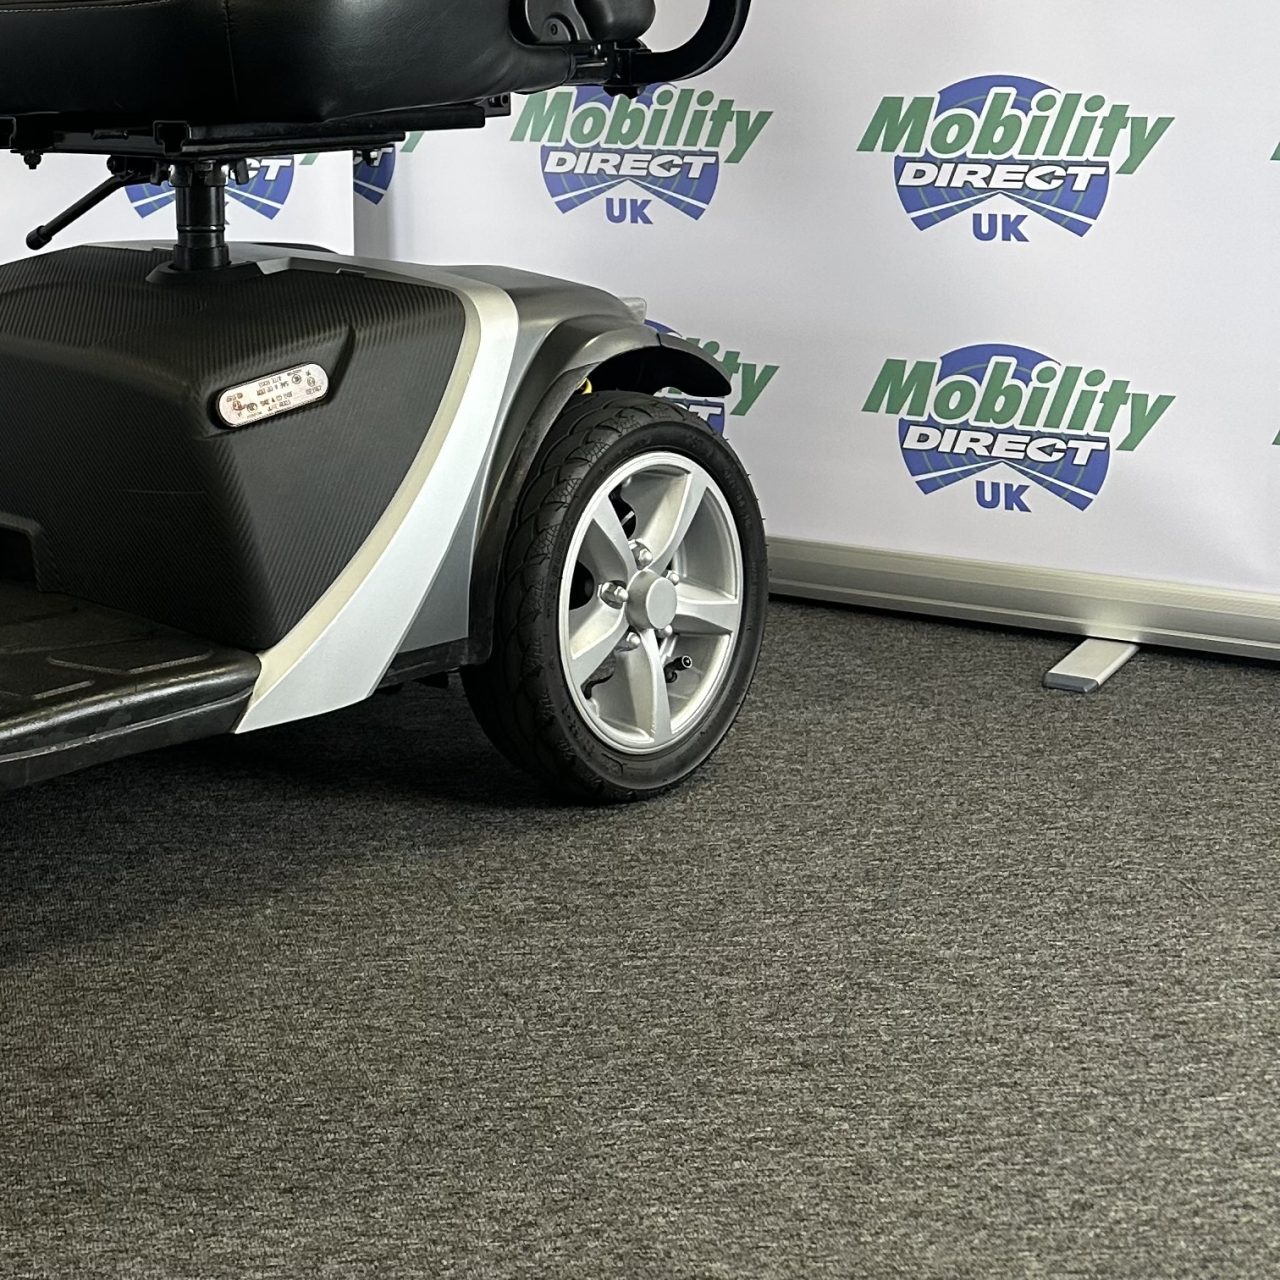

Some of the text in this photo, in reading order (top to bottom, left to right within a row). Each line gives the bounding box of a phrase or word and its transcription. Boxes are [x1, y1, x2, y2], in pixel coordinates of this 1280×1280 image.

[509, 88, 773, 164] Mobility
[856, 92, 1175, 175] Mobility
[544, 151, 717, 178] DIRECT
[898, 162, 1107, 192] DIRECT
[606, 197, 653, 225] UK
[972, 214, 1029, 243] UK
[861, 357, 1176, 452] Mobility
[902, 424, 1107, 465] DIRECT
[976, 480, 1031, 513] UK
